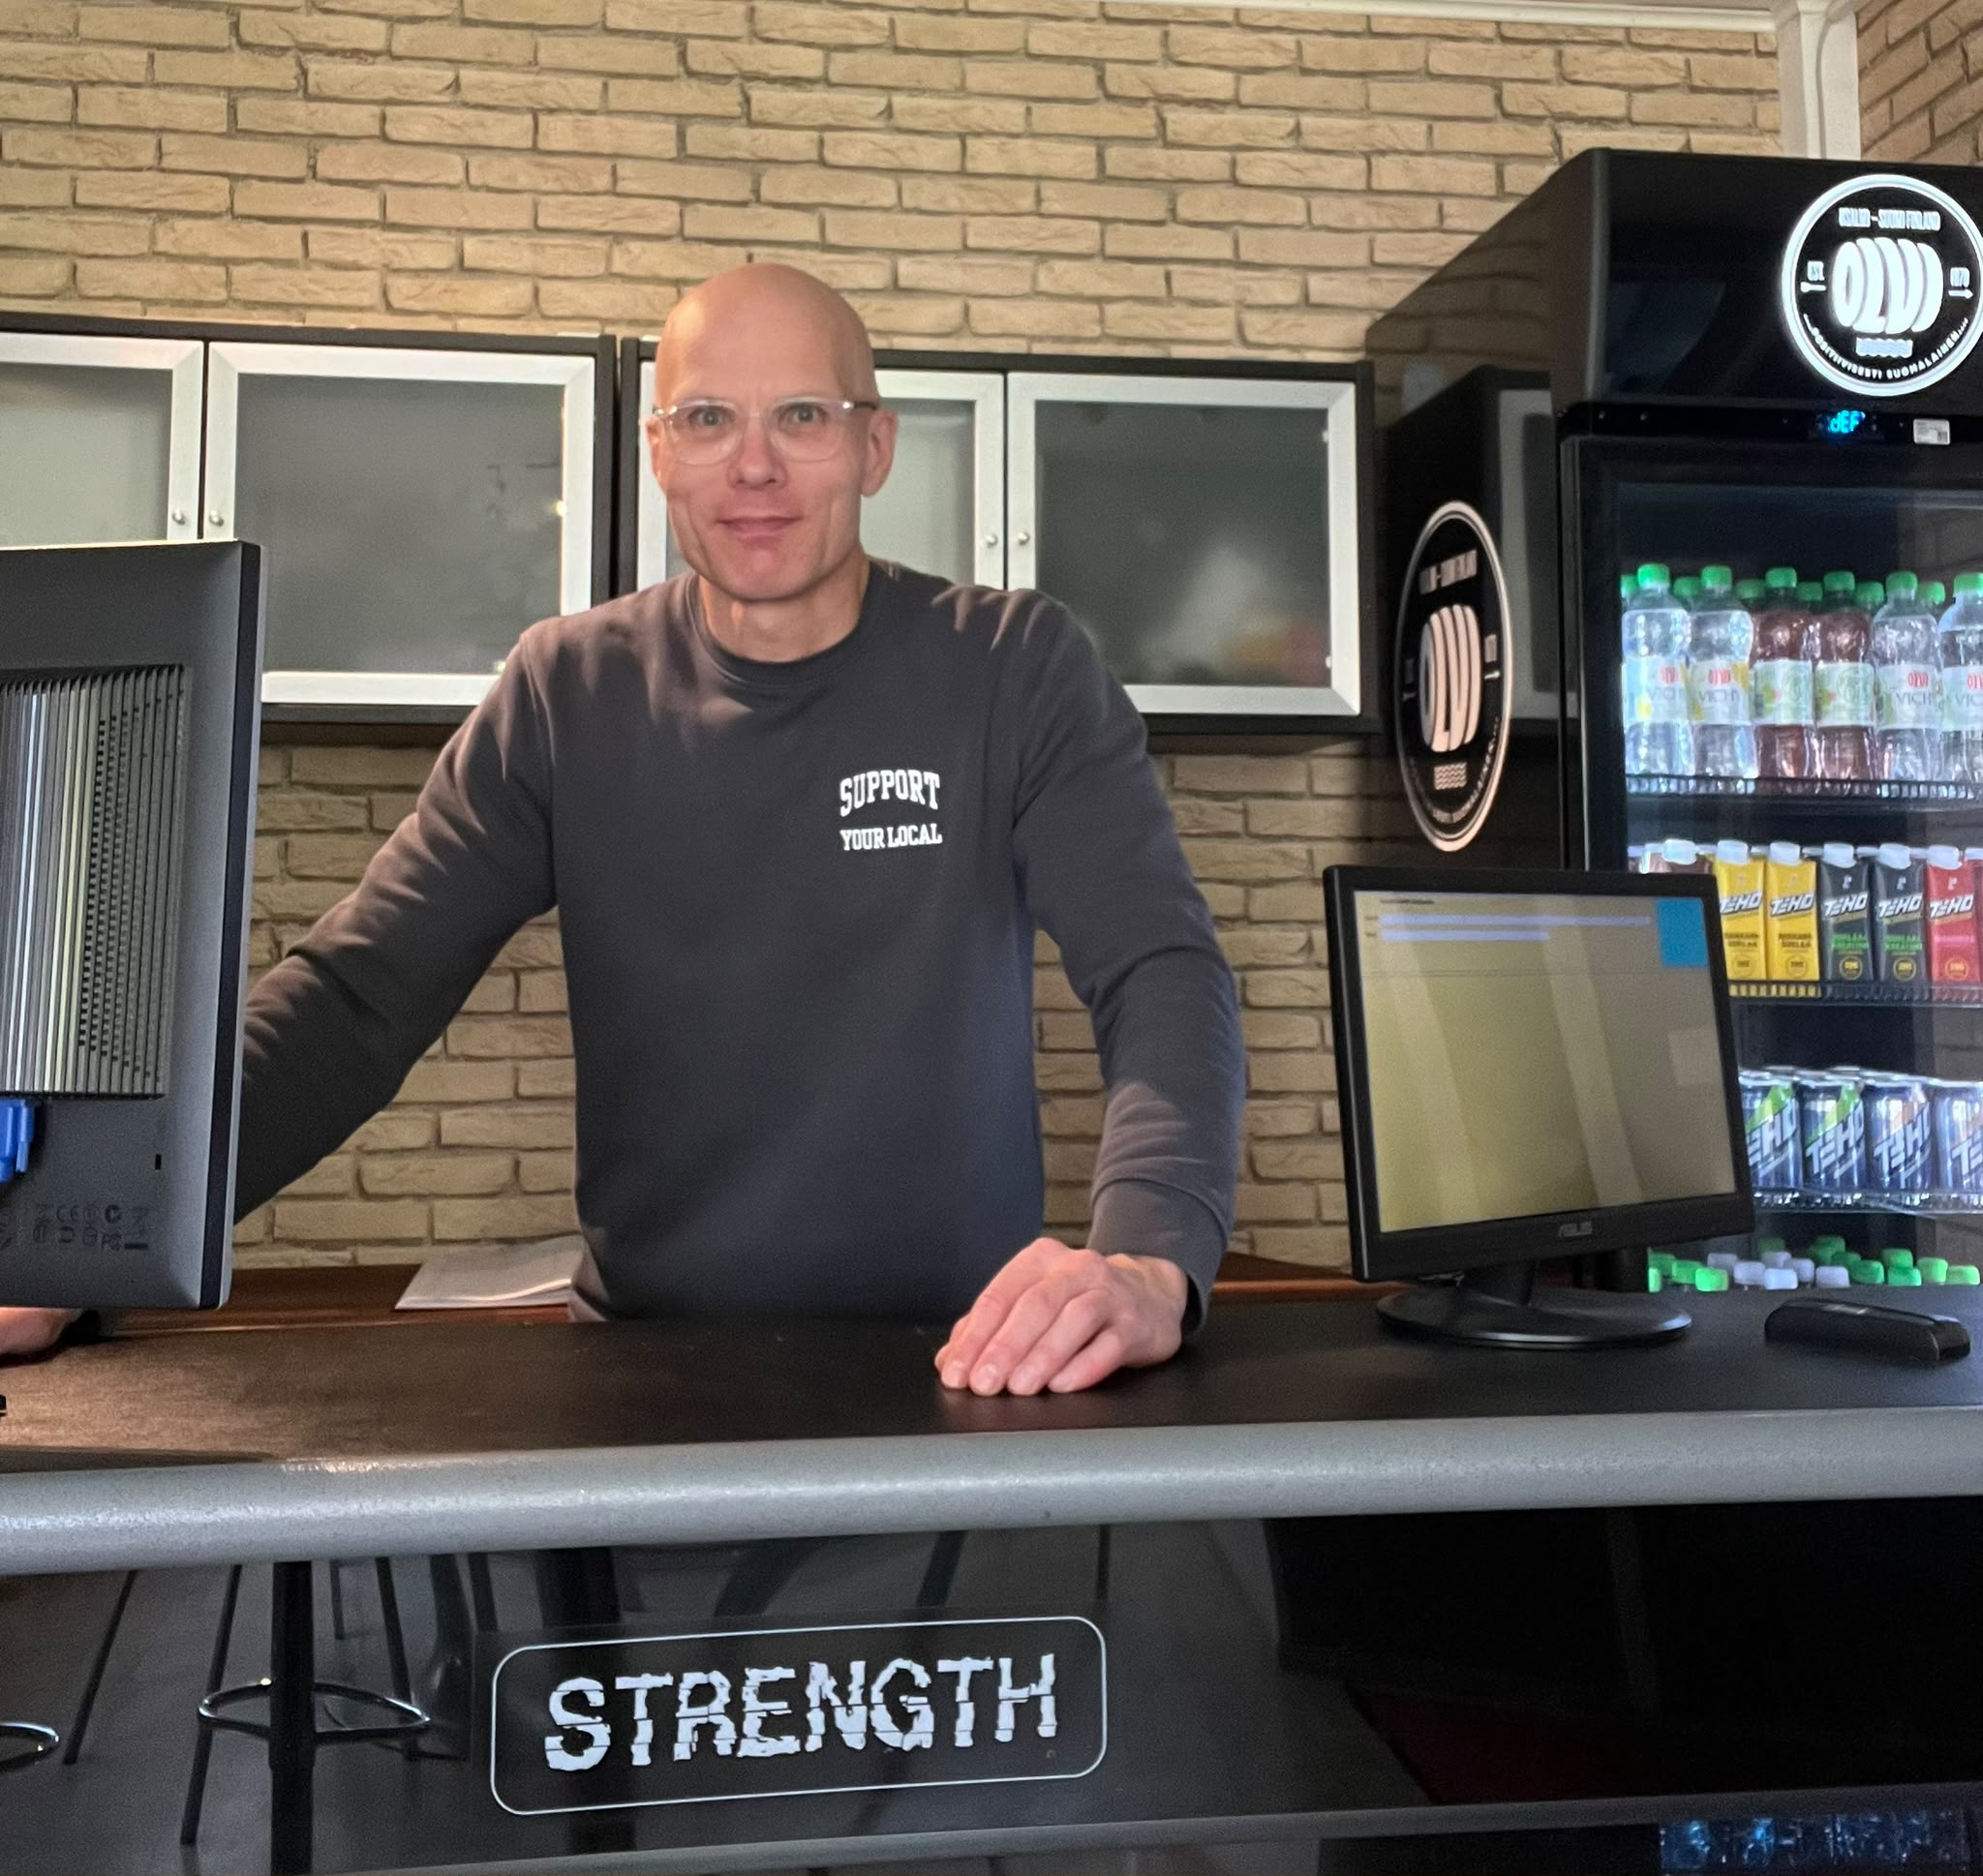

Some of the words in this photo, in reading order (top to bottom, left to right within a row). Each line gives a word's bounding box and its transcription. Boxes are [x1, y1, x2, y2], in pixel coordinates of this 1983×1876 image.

[1833, 237, 1943, 334] OLVI
[1419, 604, 1480, 752] OLVI
[839, 769, 940, 817] SUPPORT
[839, 828, 885, 851] YOUR
[887, 823, 943, 848] LOCAL
[1770, 893, 1815, 917] TEHO
[1823, 893, 1868, 918] TEHO
[1878, 893, 1923, 919] TEHO
[1930, 893, 1974, 920] TEHO
[1747, 1097, 1796, 1167] EHO
[1806, 1101, 1865, 1174] TEHO
[544, 1653, 1055, 1771] STRENGTH
